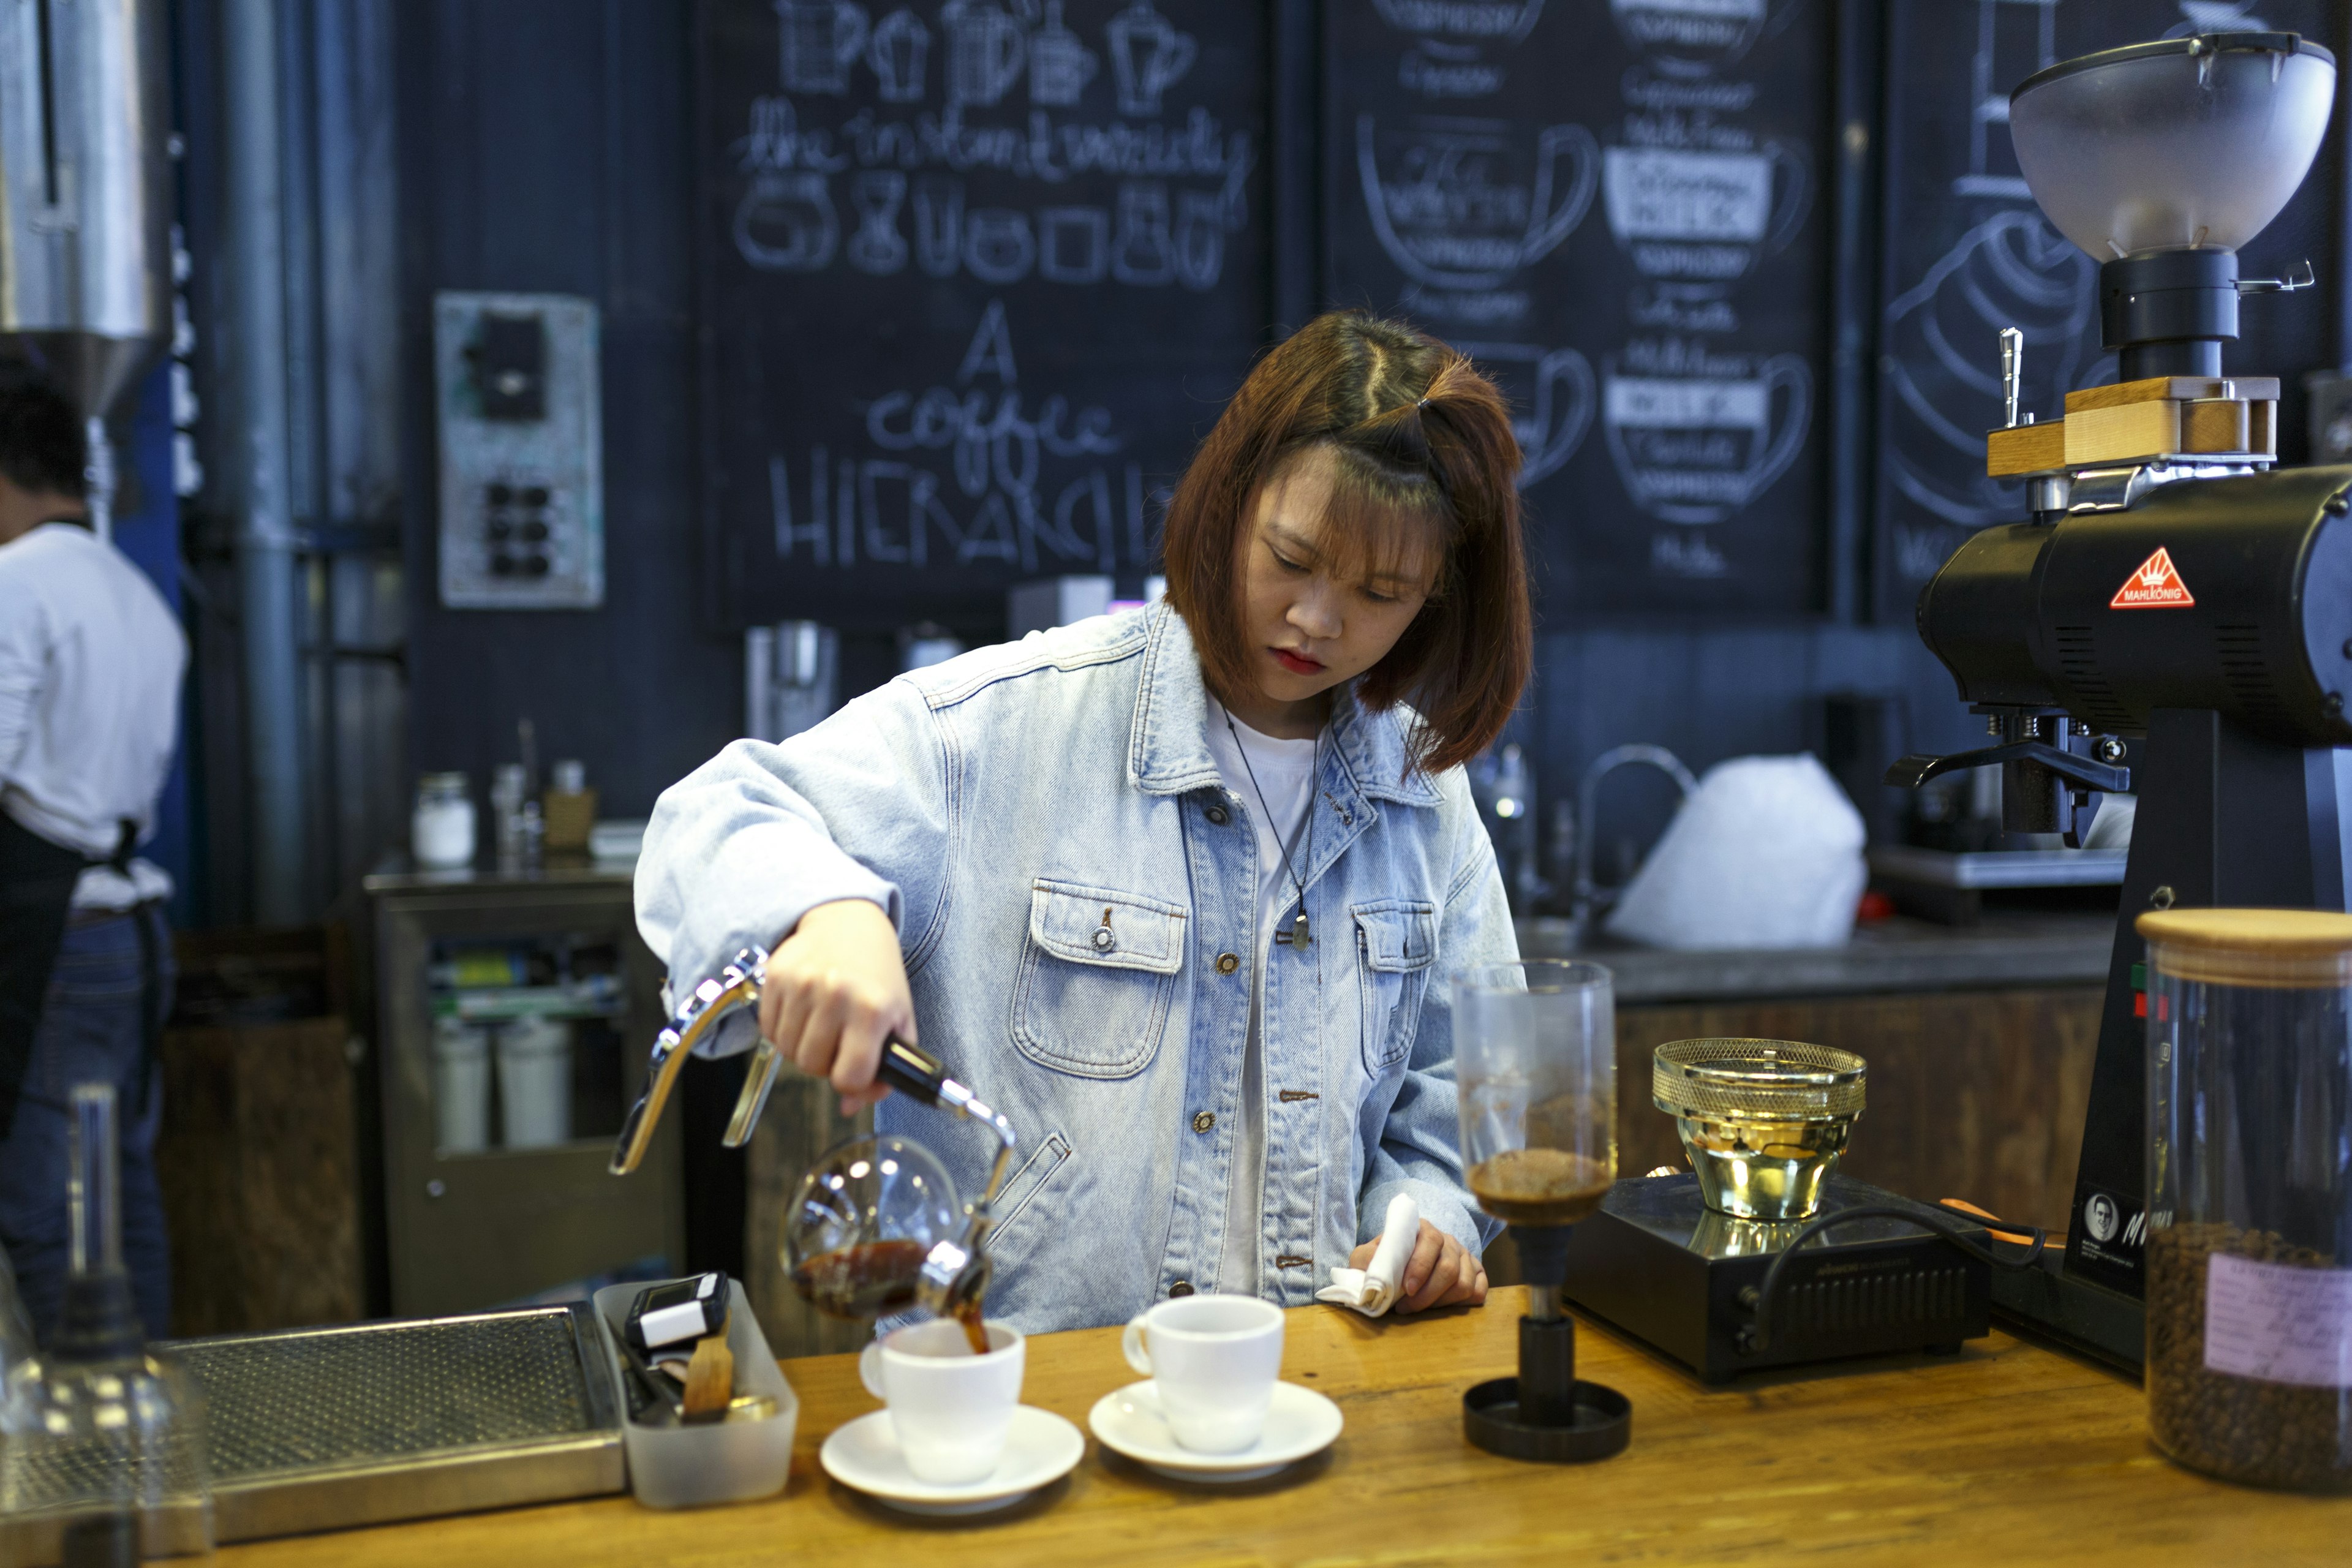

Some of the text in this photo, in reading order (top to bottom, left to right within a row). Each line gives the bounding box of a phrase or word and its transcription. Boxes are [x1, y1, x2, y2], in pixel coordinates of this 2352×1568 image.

[956, 297, 1018, 384] A
[864, 385, 1126, 496] coffee
[2125, 586, 2182, 600] MAHLKÖNIG
